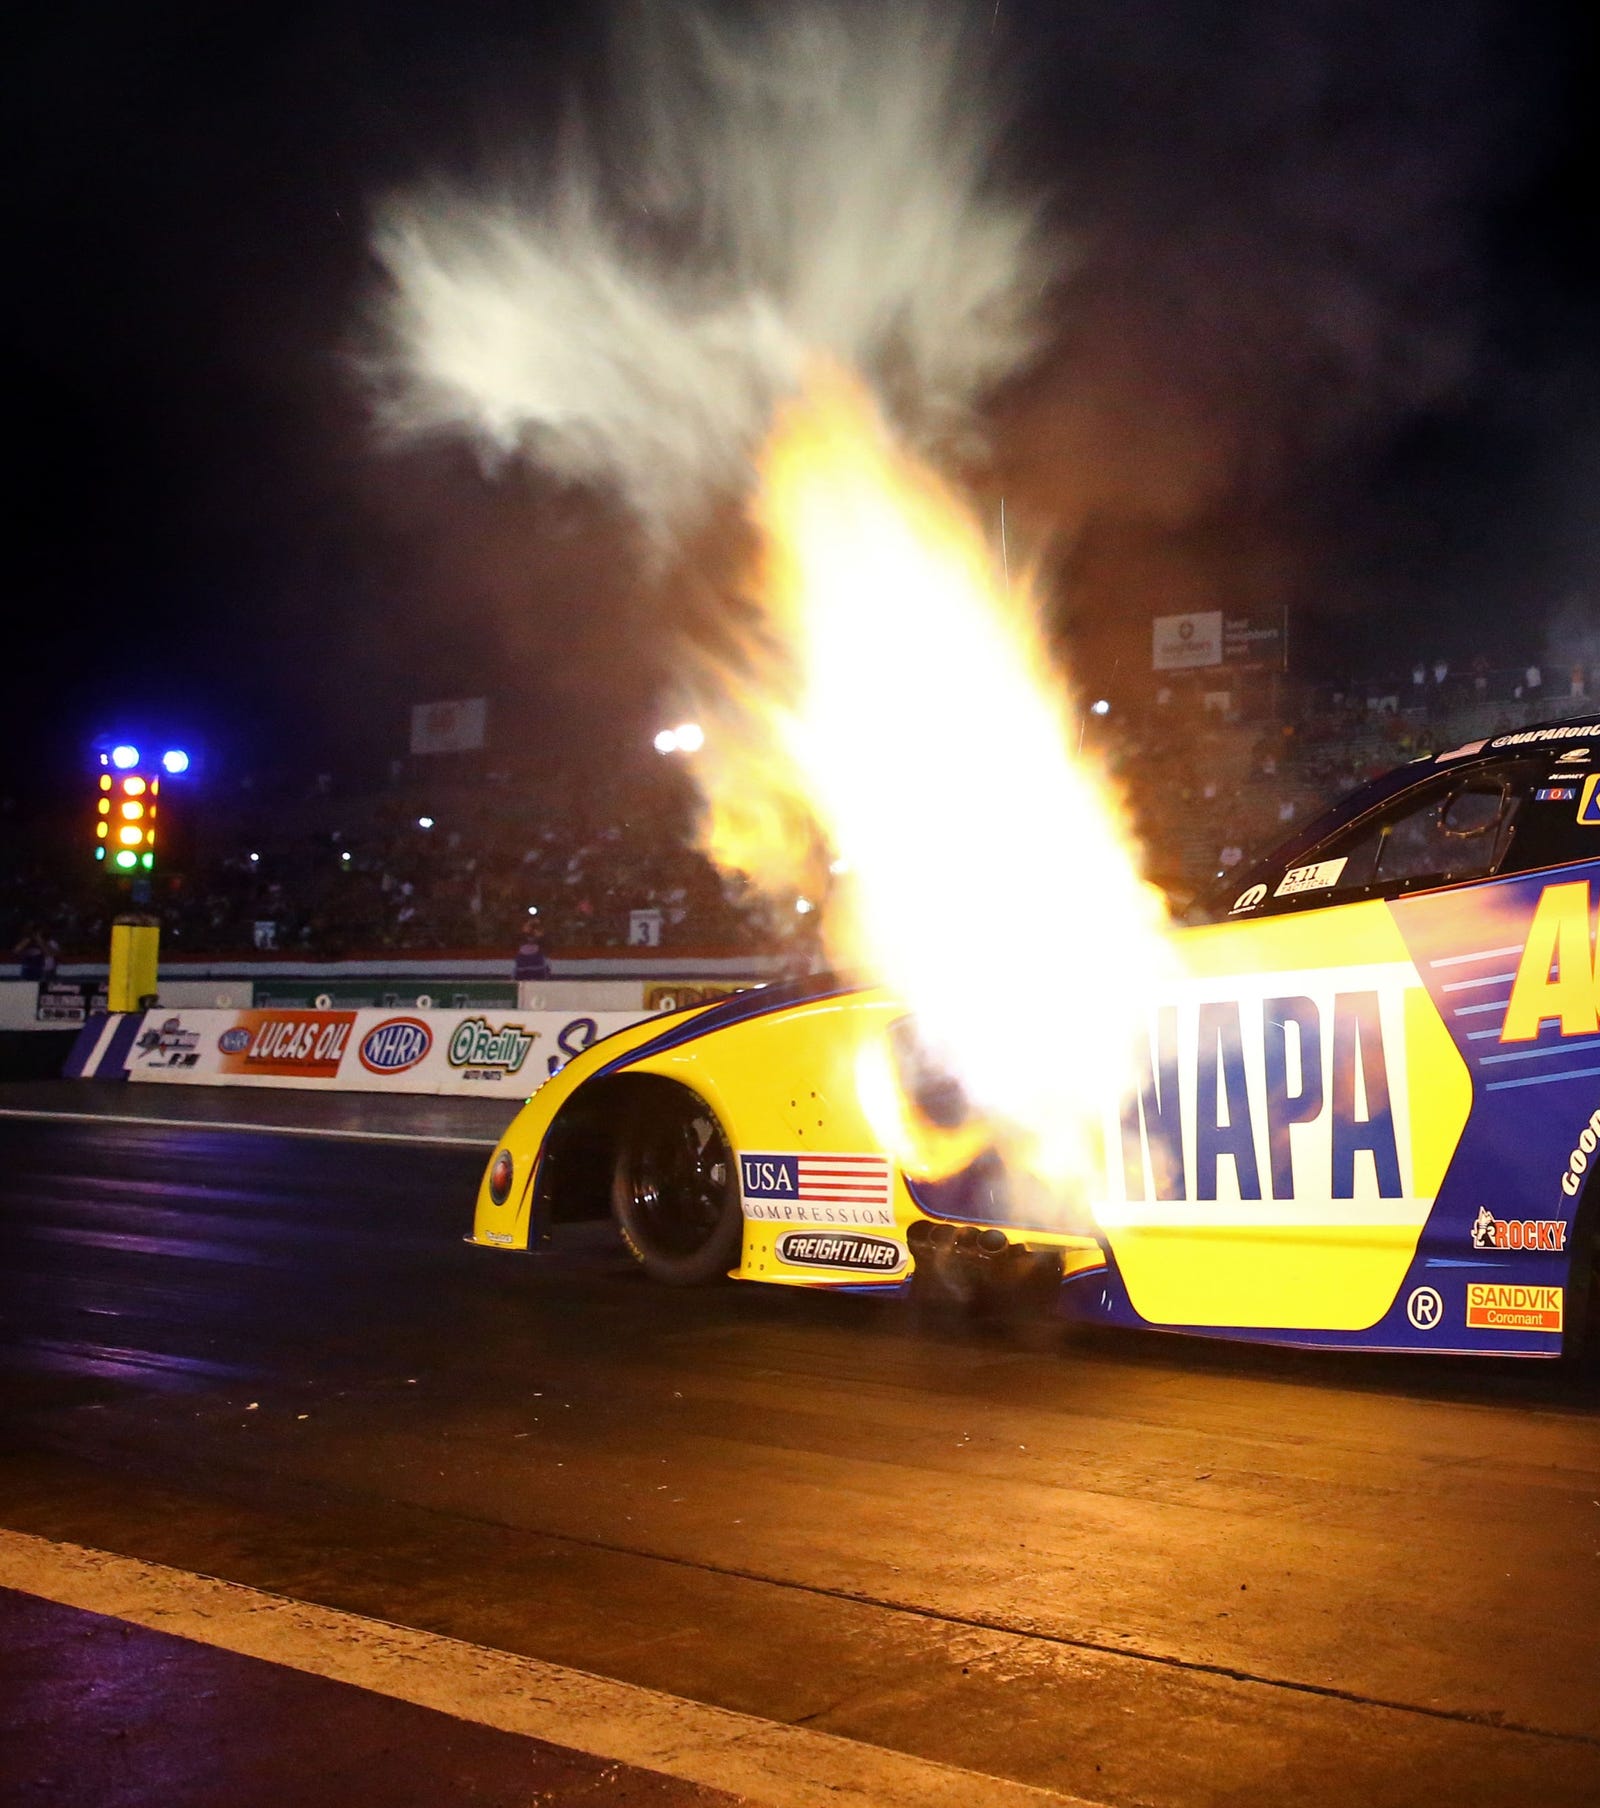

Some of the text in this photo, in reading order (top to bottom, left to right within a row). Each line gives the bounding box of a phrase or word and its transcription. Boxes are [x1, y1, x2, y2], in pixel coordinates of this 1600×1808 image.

[1281, 878, 1330, 893] TACTICAL
[1285, 866, 1320, 886] 5.11
[249, 1021, 318, 1059] LUCAS
[314, 1022, 350, 1061] OIL
[367, 1024, 424, 1067] NHRA
[451, 1019, 531, 1070] O'Reilly
[1118, 990, 1404, 1202] NAPA
[743, 1160, 793, 1194] USA
[742, 1202, 891, 1226] COMPRESSION
[1494, 1220, 1566, 1250] ROCKY
[786, 1238, 895, 1267] FREIGHTLINER
[1471, 1286, 1559, 1310] SANDVIK
[1486, 1309, 1543, 1326] Coromant
